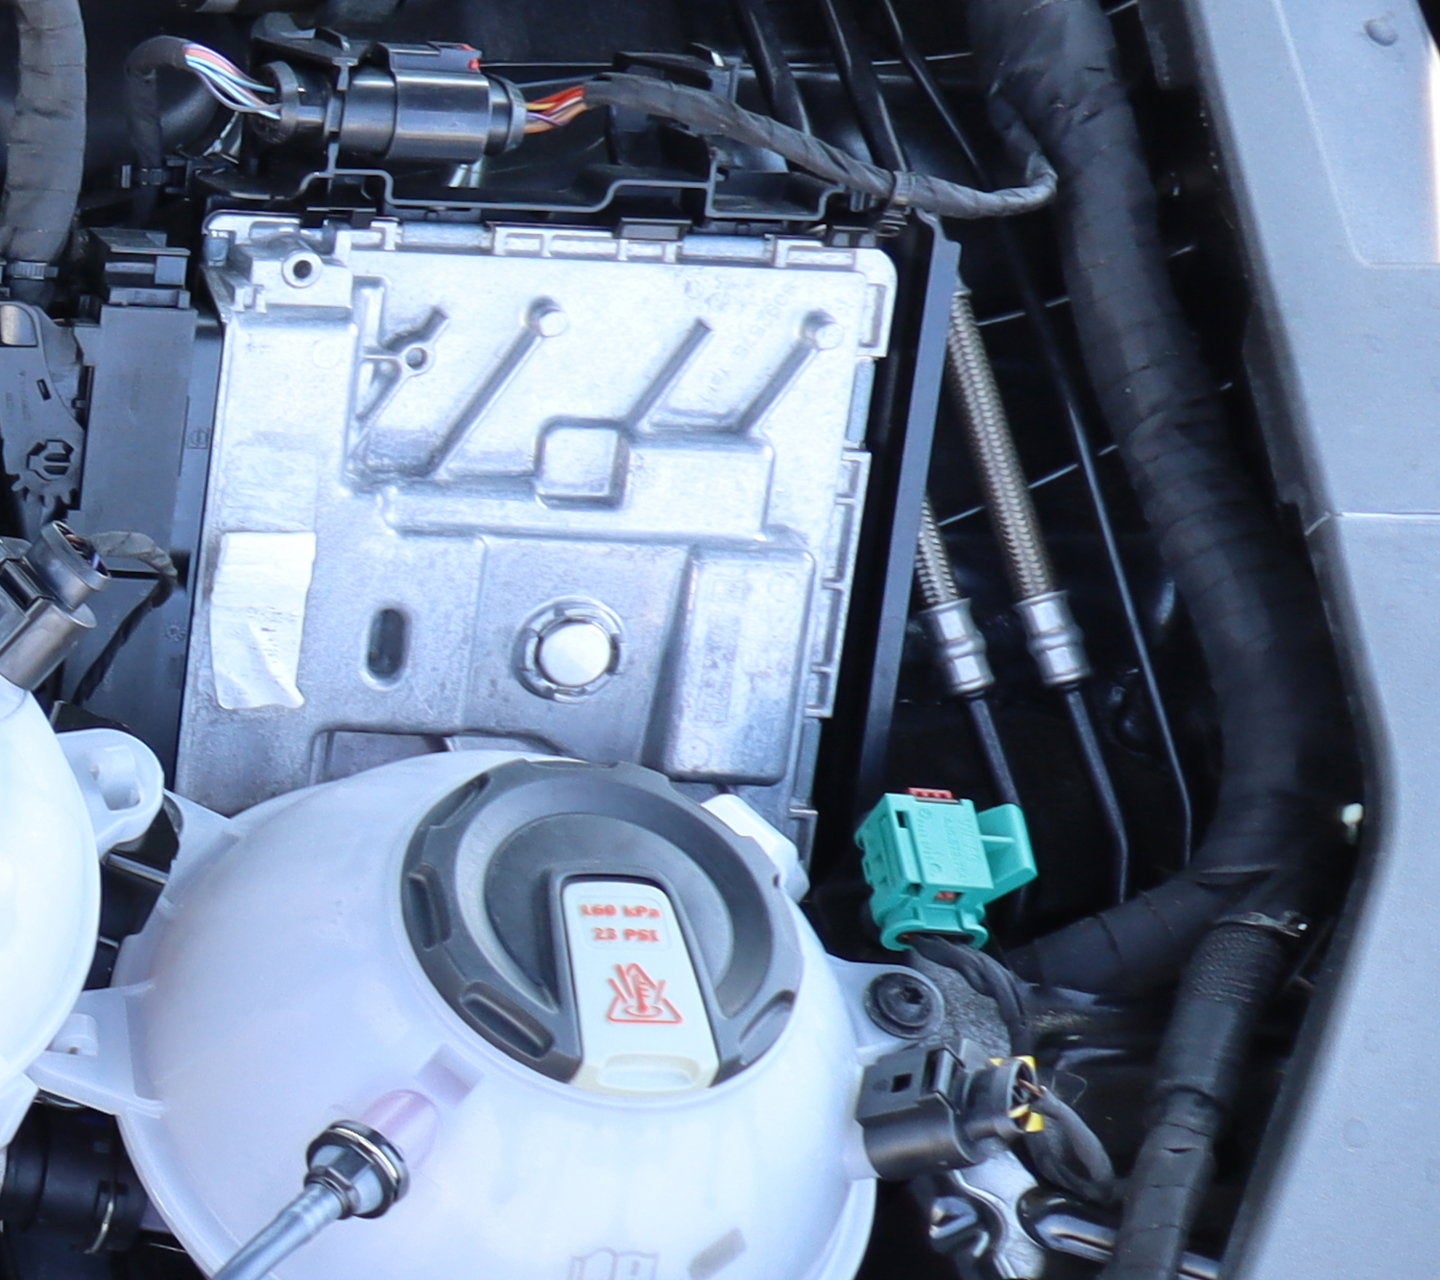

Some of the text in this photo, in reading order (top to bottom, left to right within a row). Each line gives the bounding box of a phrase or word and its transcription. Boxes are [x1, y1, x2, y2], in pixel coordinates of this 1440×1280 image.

[580, 904, 662, 919] 160 kPa
[593, 927, 660, 942] 23 PSI
